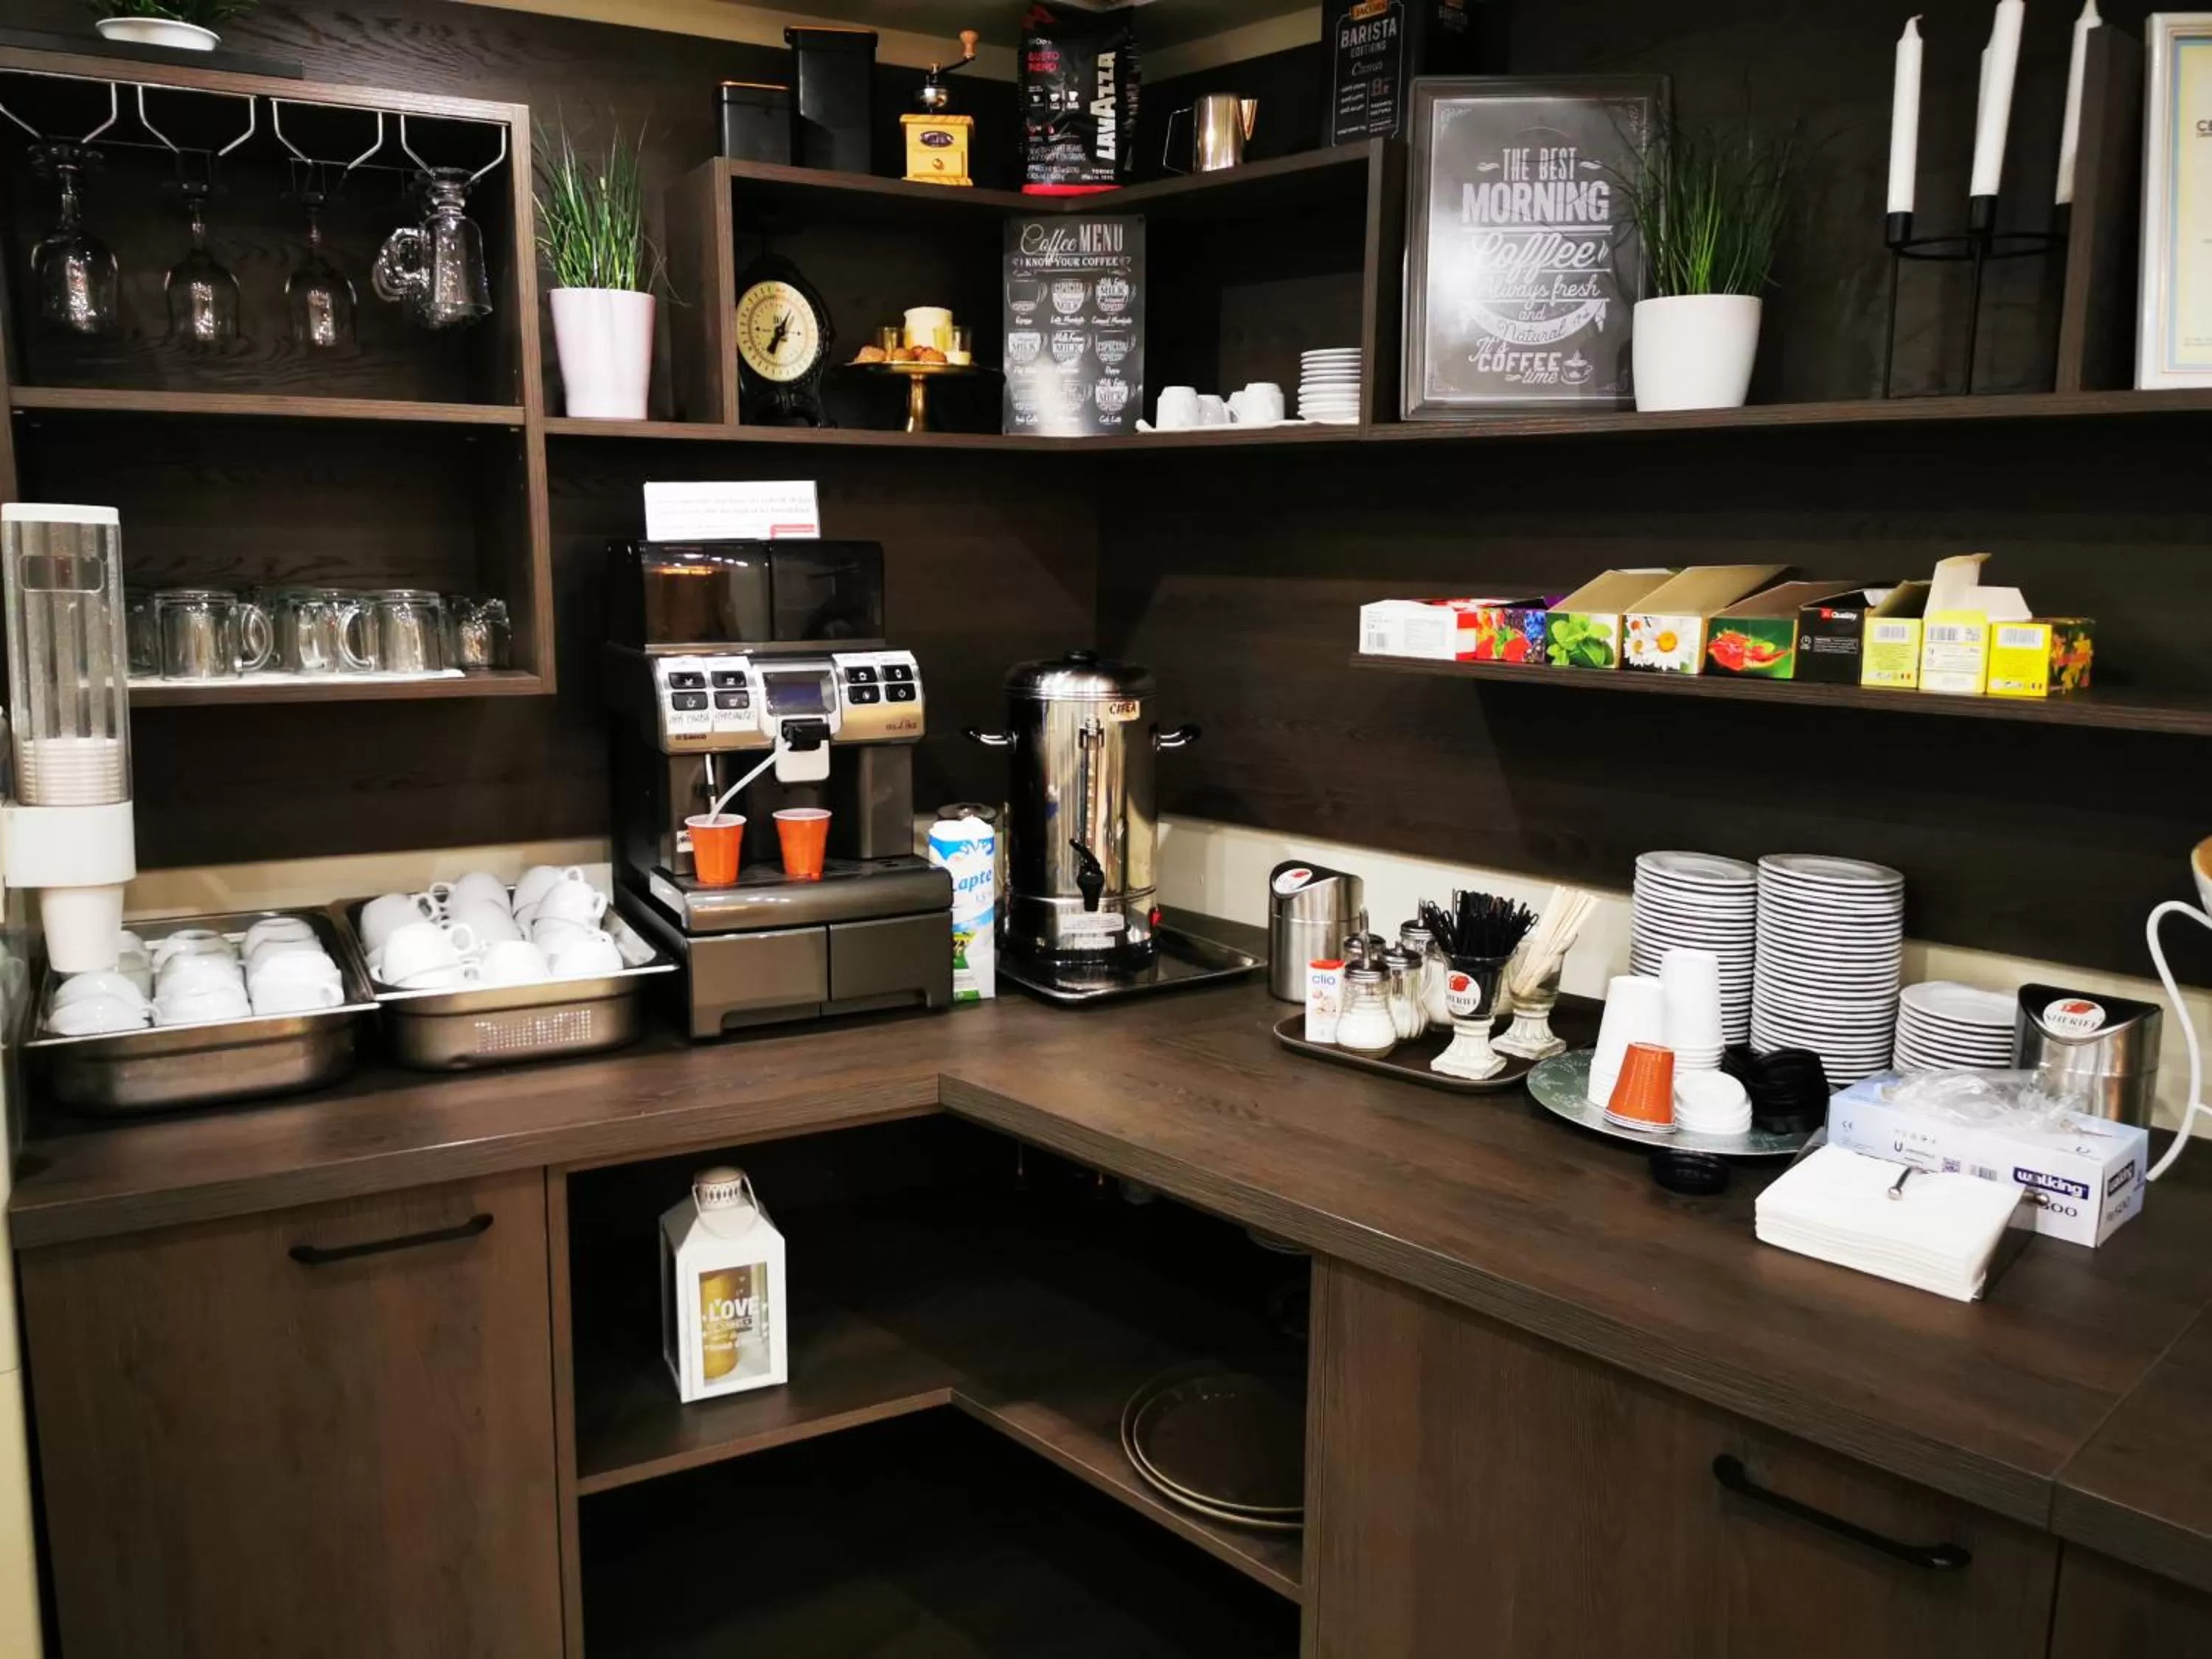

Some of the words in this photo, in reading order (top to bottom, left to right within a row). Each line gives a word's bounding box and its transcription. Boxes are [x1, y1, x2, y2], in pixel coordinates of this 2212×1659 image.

[1340, 17, 1397, 49] BARISTA
[1090, 52, 1117, 160] LAVAZZA
[1503, 147, 1531, 181] THE
[1539, 147, 1577, 181] BEST
[1462, 180, 1611, 223] MORNING
[1020, 223, 1078, 262] Coffee
[1079, 223, 1124, 252] MENU
[1473, 230, 1596, 284] Coffee
[1026, 257, 1054, 267] KNOW
[1055, 257, 1080, 267] YOUR
[1082, 257, 1119, 266] COFFEE
[1549, 274, 1601, 307] fresh
[1518, 305, 1546, 321] and
[1498, 318, 1568, 342] Natural
[1477, 352, 1563, 372] COFFEE
[1521, 369, 1559, 384] time
[953, 869, 992, 892] apte
